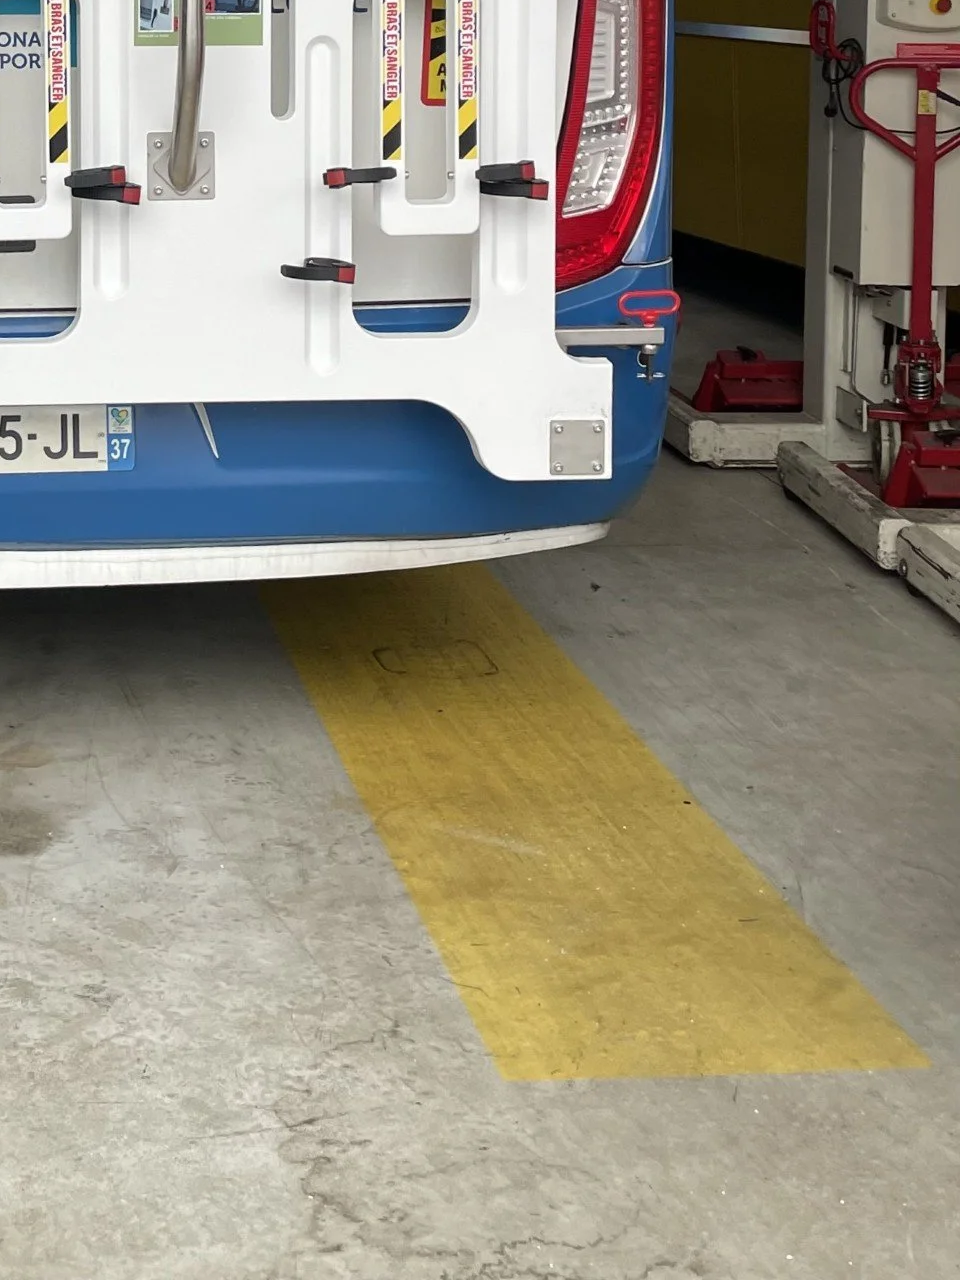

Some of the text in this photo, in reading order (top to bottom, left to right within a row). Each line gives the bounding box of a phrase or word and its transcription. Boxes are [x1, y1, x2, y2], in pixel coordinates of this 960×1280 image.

[51, 4, 62, 33] BRAS
[205, 1, 212, 11] 4
[386, 2, 398, 31] BRAS
[462, 1, 473, 30] BRAS
[51, 36, 63, 49] ET
[386, 33, 398, 46] ET
[462, 33, 473, 45] ET
[52, 51, 63, 101] SANGLER
[386, 49, 398, 99] SANGLER
[462, 49, 473, 98] SANGLER
[110, 438, 131, 459] 37
